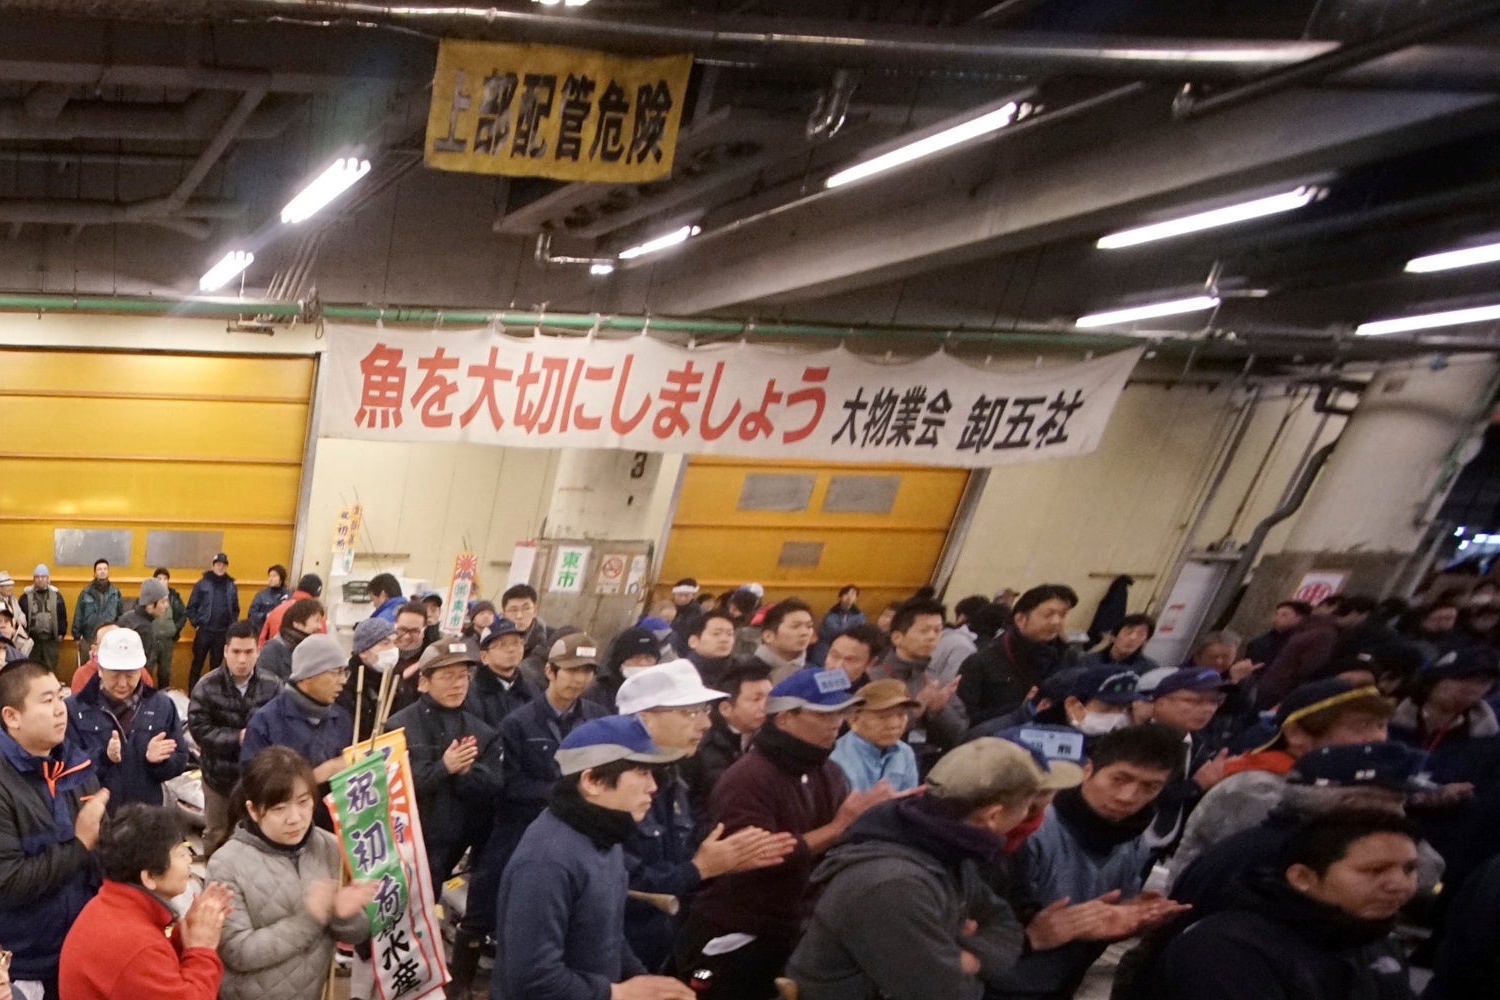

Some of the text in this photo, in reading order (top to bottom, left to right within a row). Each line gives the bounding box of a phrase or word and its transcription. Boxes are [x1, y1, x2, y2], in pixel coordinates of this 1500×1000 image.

[434, 68, 672, 164] 上部配管危険
[354, 343, 1085, 453] 魚を大切にしましょう 大物業会 卸五社
[557, 551, 582, 588] 東市
[347, 769, 401, 921] 祝初荷
